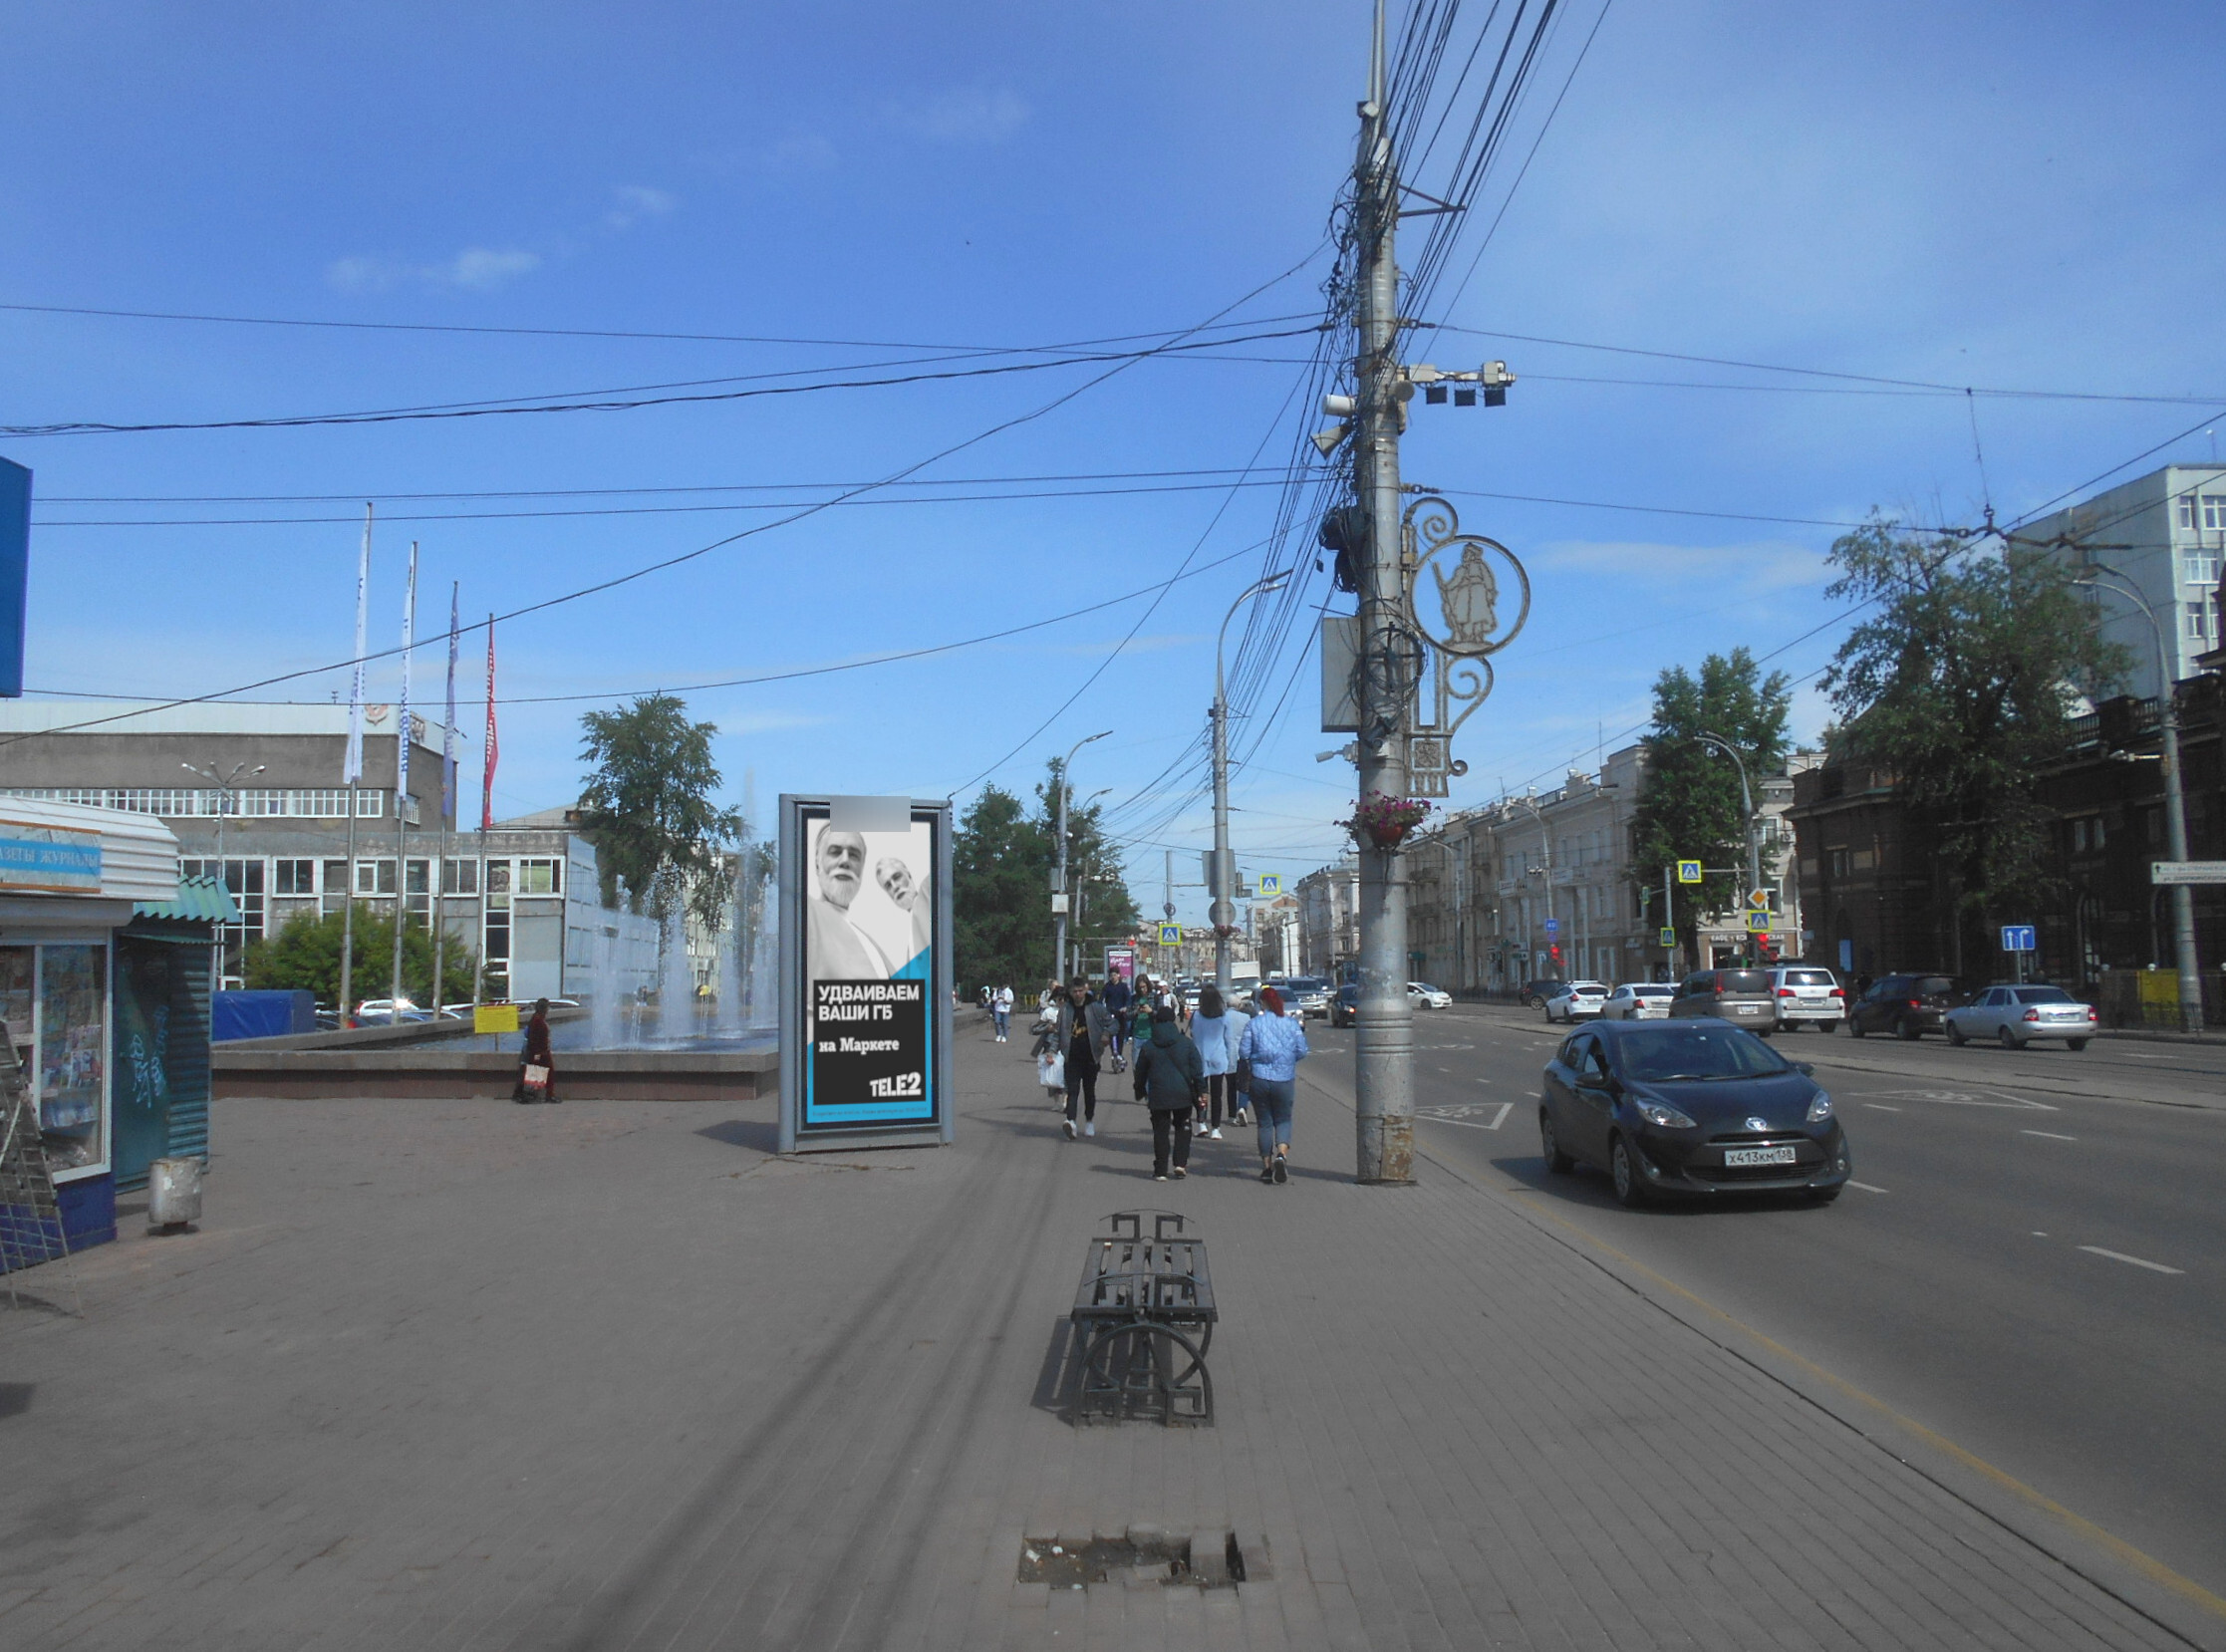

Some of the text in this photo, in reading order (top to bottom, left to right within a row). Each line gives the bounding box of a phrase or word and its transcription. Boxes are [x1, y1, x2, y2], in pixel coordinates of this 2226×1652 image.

[40, 850, 99, 868] ЖУРНАЛЫ
[818, 984, 920, 1004] УДВАИВАЕМ
[818, 1004, 893, 1021] ВАШИ ГБ
[818, 1037, 900, 1055] на Маркете
[869, 1072, 922, 1097] TELE2
